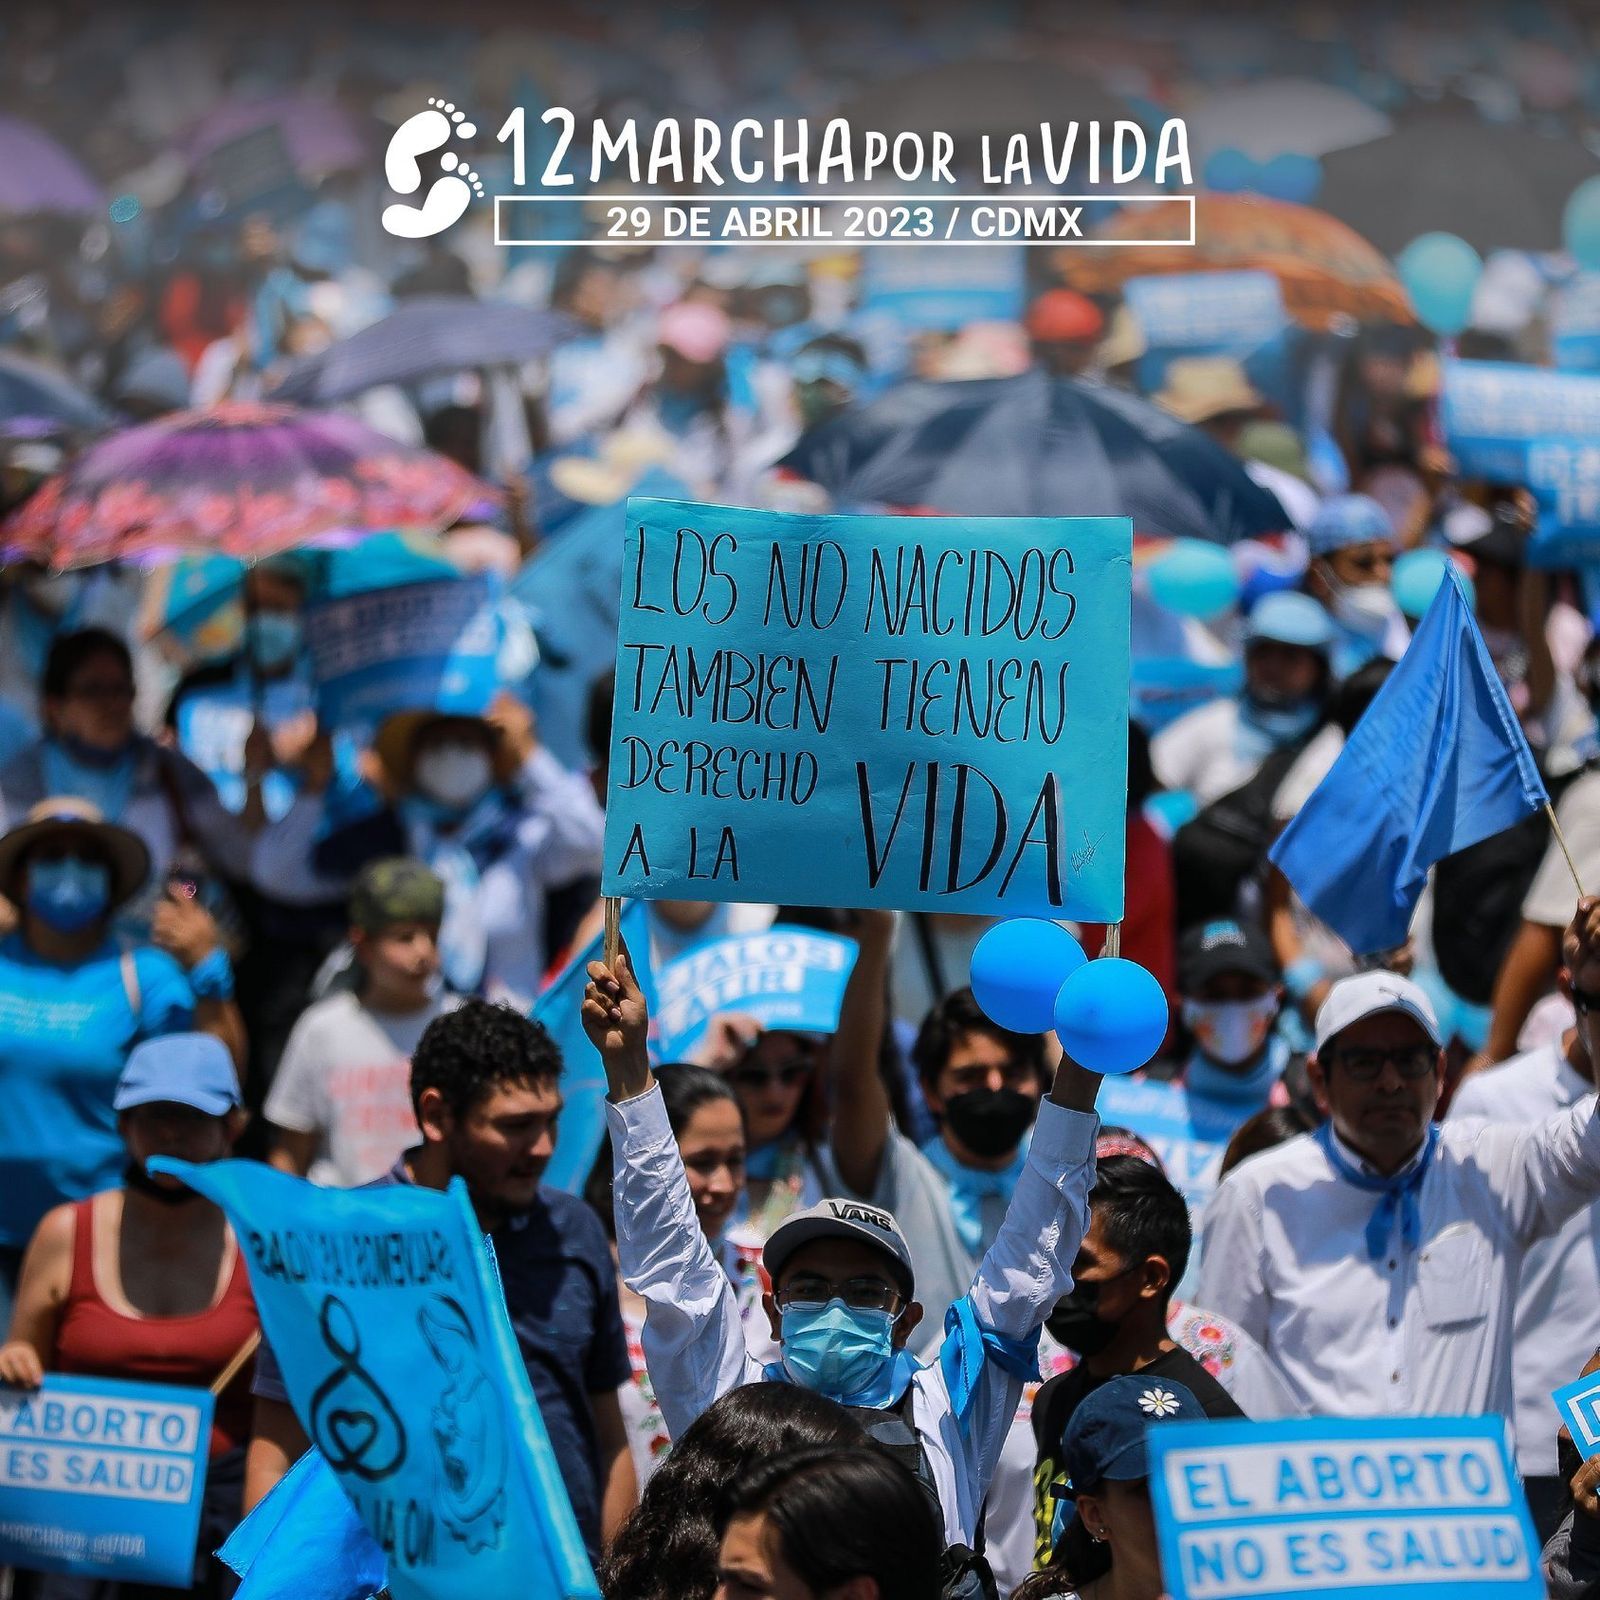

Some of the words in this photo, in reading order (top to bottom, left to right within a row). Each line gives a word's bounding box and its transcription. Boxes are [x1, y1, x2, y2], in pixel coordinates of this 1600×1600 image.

[632, 527, 737, 625] LOS
[764, 540, 848, 630] NO
[865, 544, 1077, 640] NACIDOS
[624, 644, 838, 734] TAMBIEN
[874, 658, 1070, 744] TIENEN
[617, 736, 818, 805] DERECHO
[618, 824, 650, 876] A
[688, 826, 739, 881] LA
[856, 760, 1063, 907] VIDA
[829, 1202, 893, 1232] VANS
[13, 1398, 185, 1446] ABORTO
[8, 1450, 49, 1481] ES
[65, 1455, 184, 1494] SALUD
[1184, 1464, 1250, 1509] EL
[1277, 1453, 1491, 1503] ABORTO
[1190, 1539, 1265, 1584] NO
[1286, 1532, 1348, 1575] ES
[1366, 1529, 1518, 1572] SALUD
